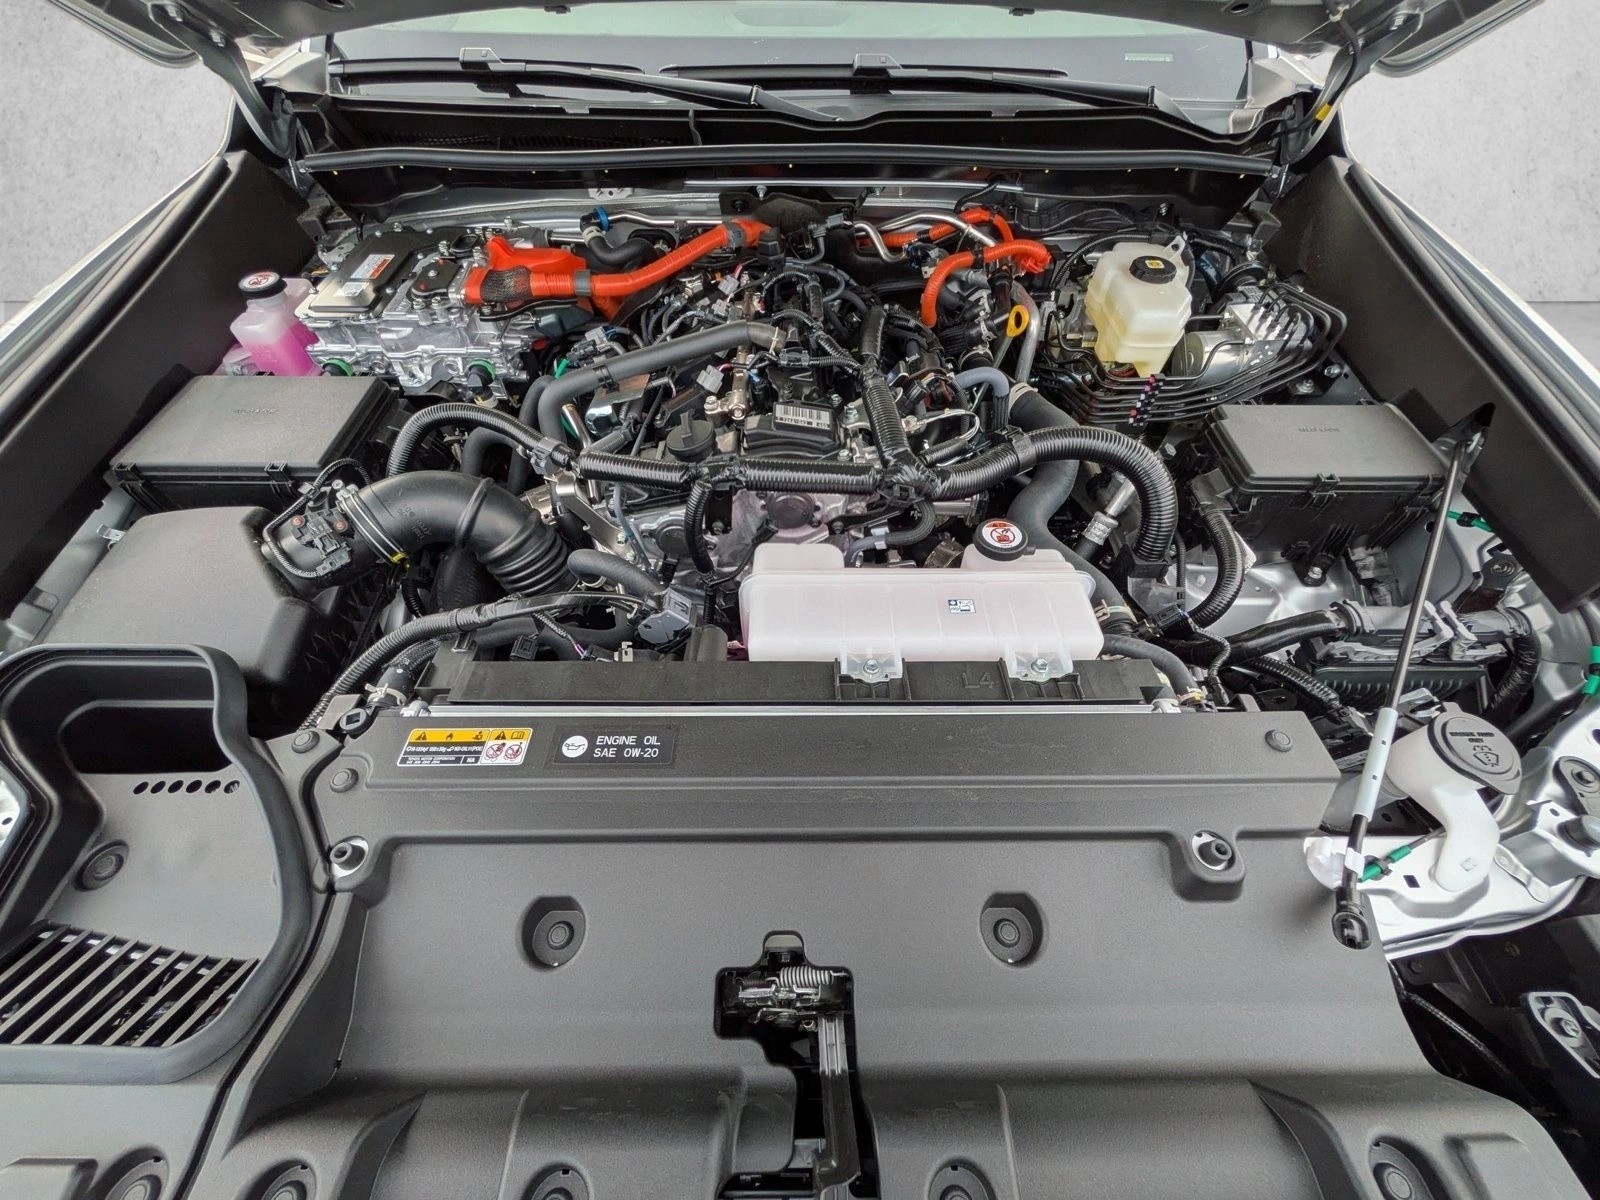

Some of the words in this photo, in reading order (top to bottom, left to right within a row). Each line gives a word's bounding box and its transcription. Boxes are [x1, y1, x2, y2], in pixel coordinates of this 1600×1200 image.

[595, 735, 637, 745] ENGINE
[643, 735, 661, 745] OIL
[593, 748, 617, 758] SAE
[623, 748, 659, 758] 0W-20
